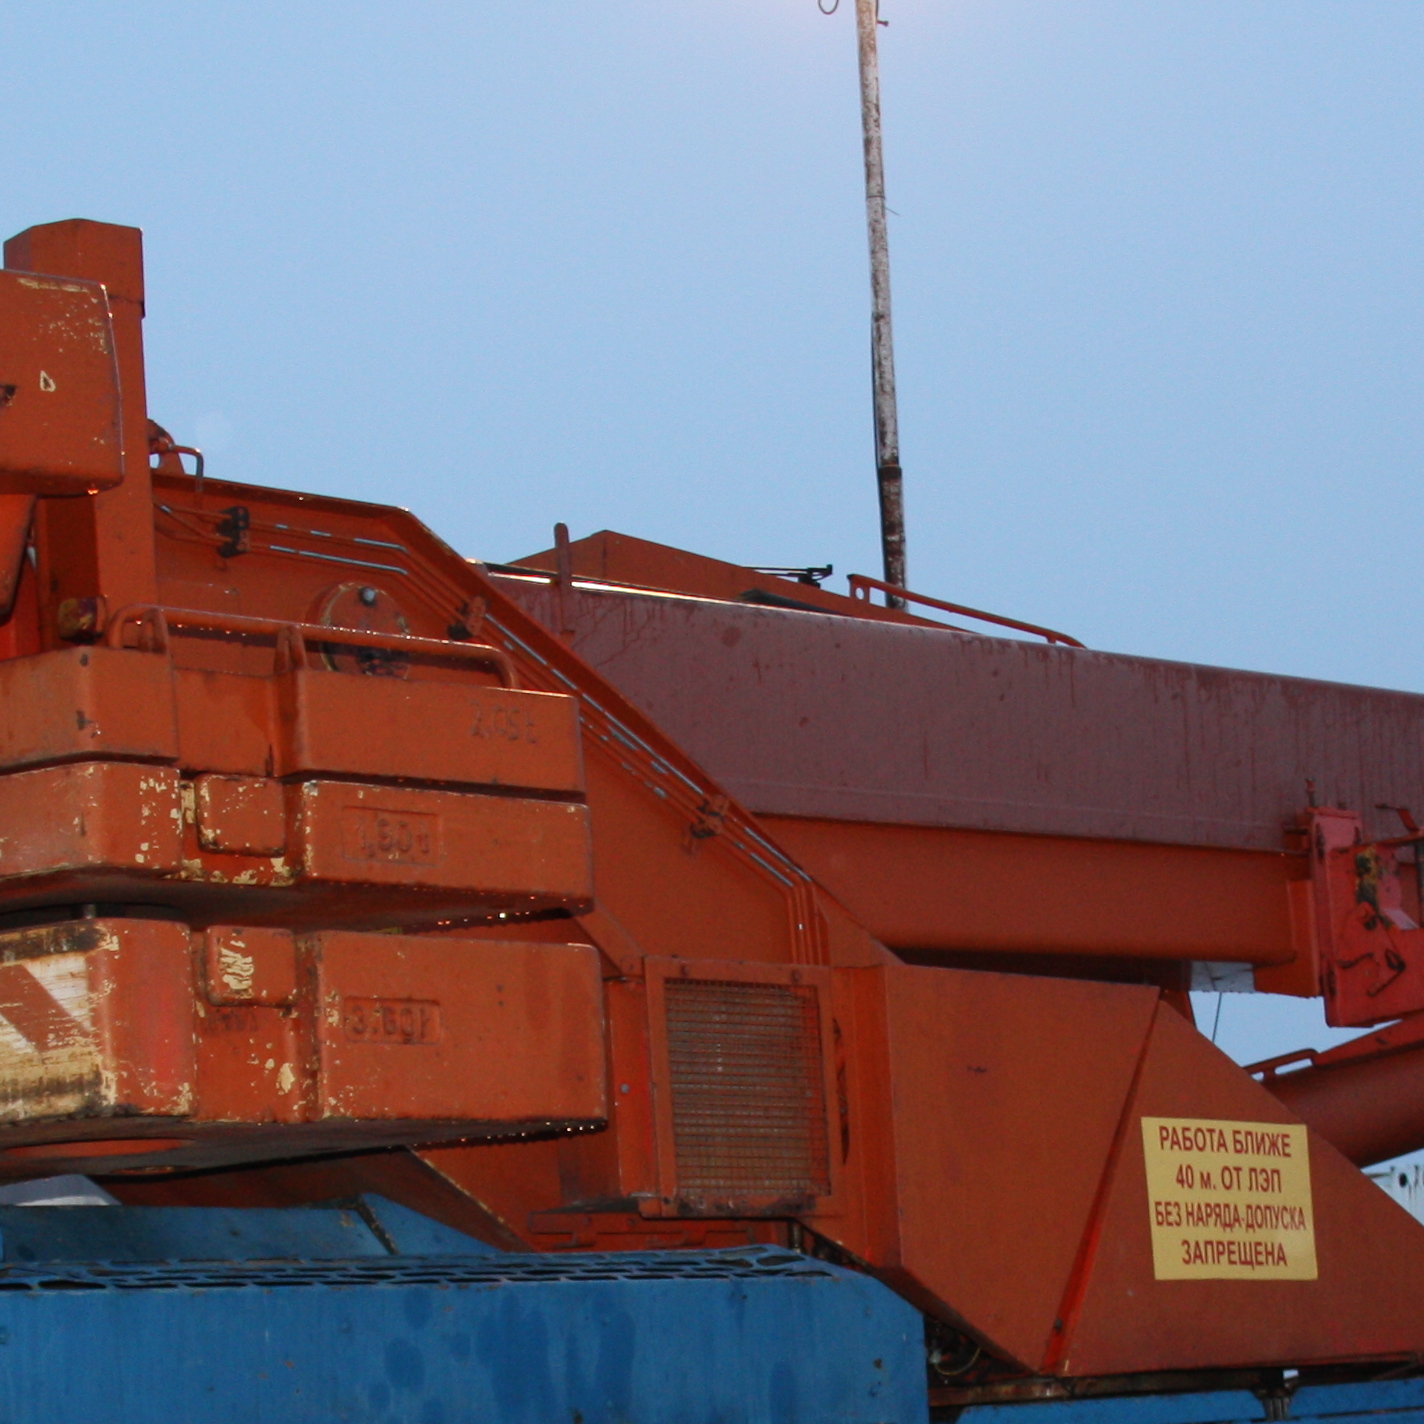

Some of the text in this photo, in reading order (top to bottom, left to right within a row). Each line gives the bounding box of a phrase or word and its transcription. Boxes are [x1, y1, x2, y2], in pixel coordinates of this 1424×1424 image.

[1159, 1126, 1291, 1157] РАБОТА БЛИЖЕ
[1176, 1164, 1282, 1193] 40 м. ОТ ЛЭП
[1155, 1201, 1307, 1233] БЕЗ НАРЯДА-ДОПУСКА
[1181, 1239, 1288, 1270] ЗАПРЕЩЕНА
